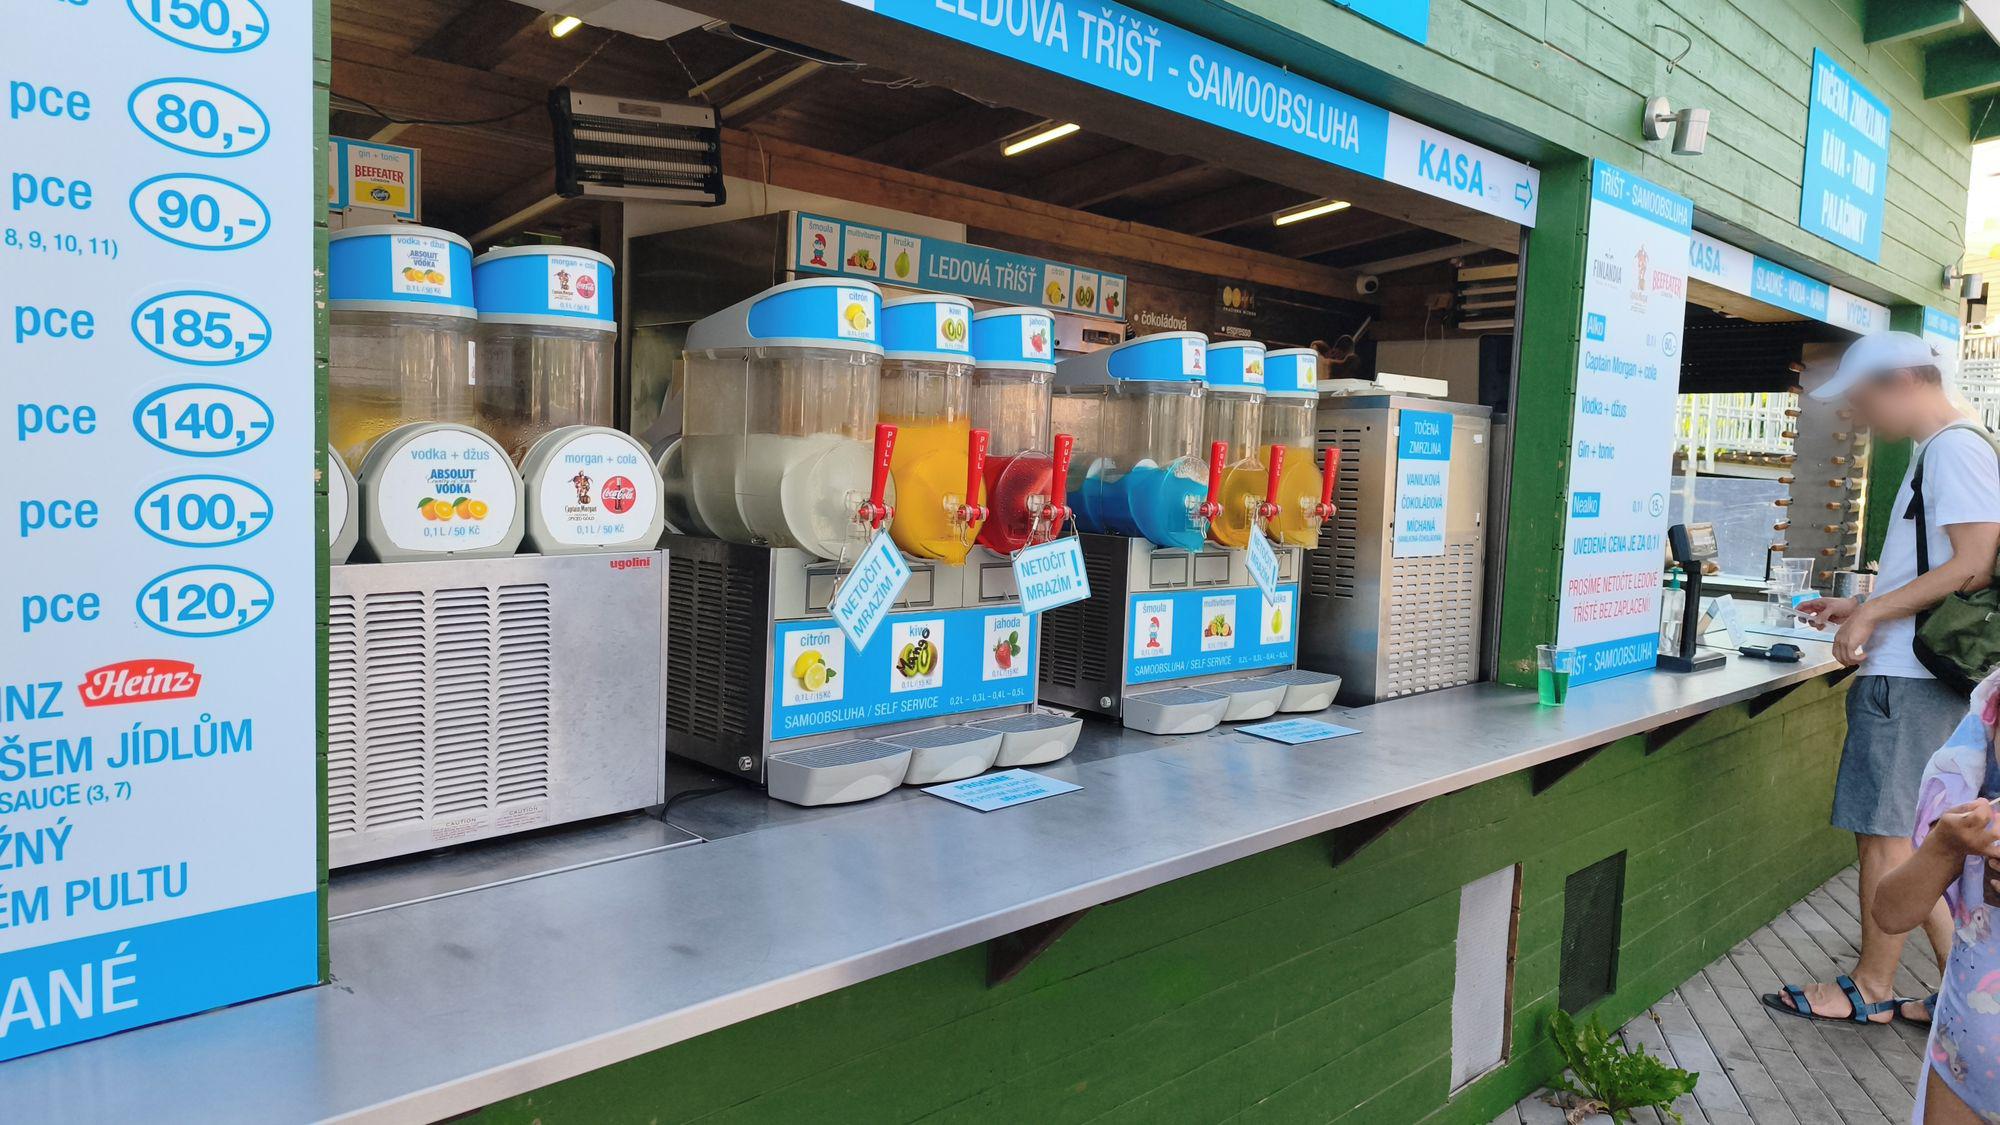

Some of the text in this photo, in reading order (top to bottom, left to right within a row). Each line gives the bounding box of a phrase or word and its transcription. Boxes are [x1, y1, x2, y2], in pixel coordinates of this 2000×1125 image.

[1077, 7, 1162, 81] TŘÍŠŤ
[1168, 67, 1179, 77] -
[1187, 54, 1360, 154] SAMOOBSLUHA
[9, 80, 91, 121] pce
[155, 94, 256, 150] 80,-
[354, 164, 405, 185] BEEFEATER
[1418, 138, 1484, 197] KASA
[12, 171, 92, 210] pce
[157, 193, 256, 242] 90,-
[1632, 184, 1688, 227] SAMOOBSLUHA
[808, 220, 833, 233] šmoula
[28, 230, 47, 252] 9,
[53, 233, 83, 256] 10,
[89, 237, 119, 259] 11)
[397, 236, 421, 247] vodka
[894, 236, 914, 248] hruška
[409, 250, 439, 259] ABSOLUT
[413, 259, 436, 268] VODKA
[551, 258, 577, 268] morgan
[929, 253, 1037, 294] LEDOVÁ TŘÍŠŤ
[1592, 258, 1622, 285] FINLANDIA
[1652, 269, 1682, 300] BEEFEATER
[15, 305, 95, 343] pce
[144, 307, 266, 357] 185,-
[1141, 310, 1188, 331] čokoládová
[1226, 326, 1252, 338] espresso
[1587, 315, 1605, 337] Alko
[1585, 350, 1612, 373] Captain
[1612, 355, 1637, 382] Morgan
[1581, 394, 1603, 415] Vodka
[1611, 399, 1627, 418] džus
[17, 403, 97, 441] pce
[146, 402, 267, 447] 140,-
[1414, 420, 1440, 435] TOČENÁ
[411, 448, 490, 460] vodka + džus
[565, 454, 603, 465] morgan
[616, 454, 637, 465] cola
[883, 431, 893, 467] PULL
[977, 436, 985, 469] PULL
[1062, 441, 1070, 472] PULL
[1409, 440, 1441, 455] ZMRZLINA
[1577, 440, 1589, 458] Gin
[1598, 442, 1615, 460] tonic
[430, 468, 477, 479] ABSOLUT
[1406, 472, 1441, 486] VANILKOVÁ
[435, 483, 471, 494] VODKA
[1401, 495, 1443, 509] ČOKOLÁDOVÁ
[1573, 494, 1598, 514] Nealko
[20, 499, 99, 537] pce
[149, 493, 267, 539] 100,-
[1406, 518, 1436, 532] MÍCHANÁ
[454, 526, 466, 537] 50
[468, 525, 480, 535] Kč
[603, 525, 613, 534] 50
[614, 524, 625, 533] Kč
[1573, 532, 1606, 555] UVEDENÁ
[1608, 536, 1626, 552] CENA
[1628, 535, 1636, 551] JE
[1637, 535, 1645, 550] ZA
[609, 557, 651, 570] ugolini
[1021, 549, 1068, 577] NETOČIT
[1025, 548, 1082, 602] MRAZÍM !
[841, 556, 884, 620] NETOČIT
[1568, 569, 1658, 597] PROSÍME NETOČTE LEDOVÉ
[22, 592, 100, 632] pce
[149, 582, 268, 625] 120,-
[853, 577, 893, 638] MRAZÍM
[1142, 603, 1167, 614] šmoula
[1599, 602, 1613, 619] BEZ
[994, 617, 1021, 632] jahoda
[800, 632, 831, 647] citrón
[1134, 662, 1185, 676] SAMOOBSLUHA
[1190, 659, 1206, 670] SELF
[1207, 656, 1232, 668] SERVICE
[1594, 641, 1653, 672] SAMOOBSLUHA
[0, 667, 194, 723] NZ Heinz
[785, 706, 865, 729] SAMOOBSLUHA
[874, 702, 898, 716] SELF
[901, 696, 938, 712] SERVICE
[107, 712, 252, 769] JÍDLŮM
[87, 783, 109, 805] (3,
[114, 781, 132, 801] 7)
[445, 817, 477, 827] CAUTION
[508, 806, 538, 816] CAUTION
[65, 862, 188, 917] PULTU
[0, 940, 138, 1038] ANÉ
